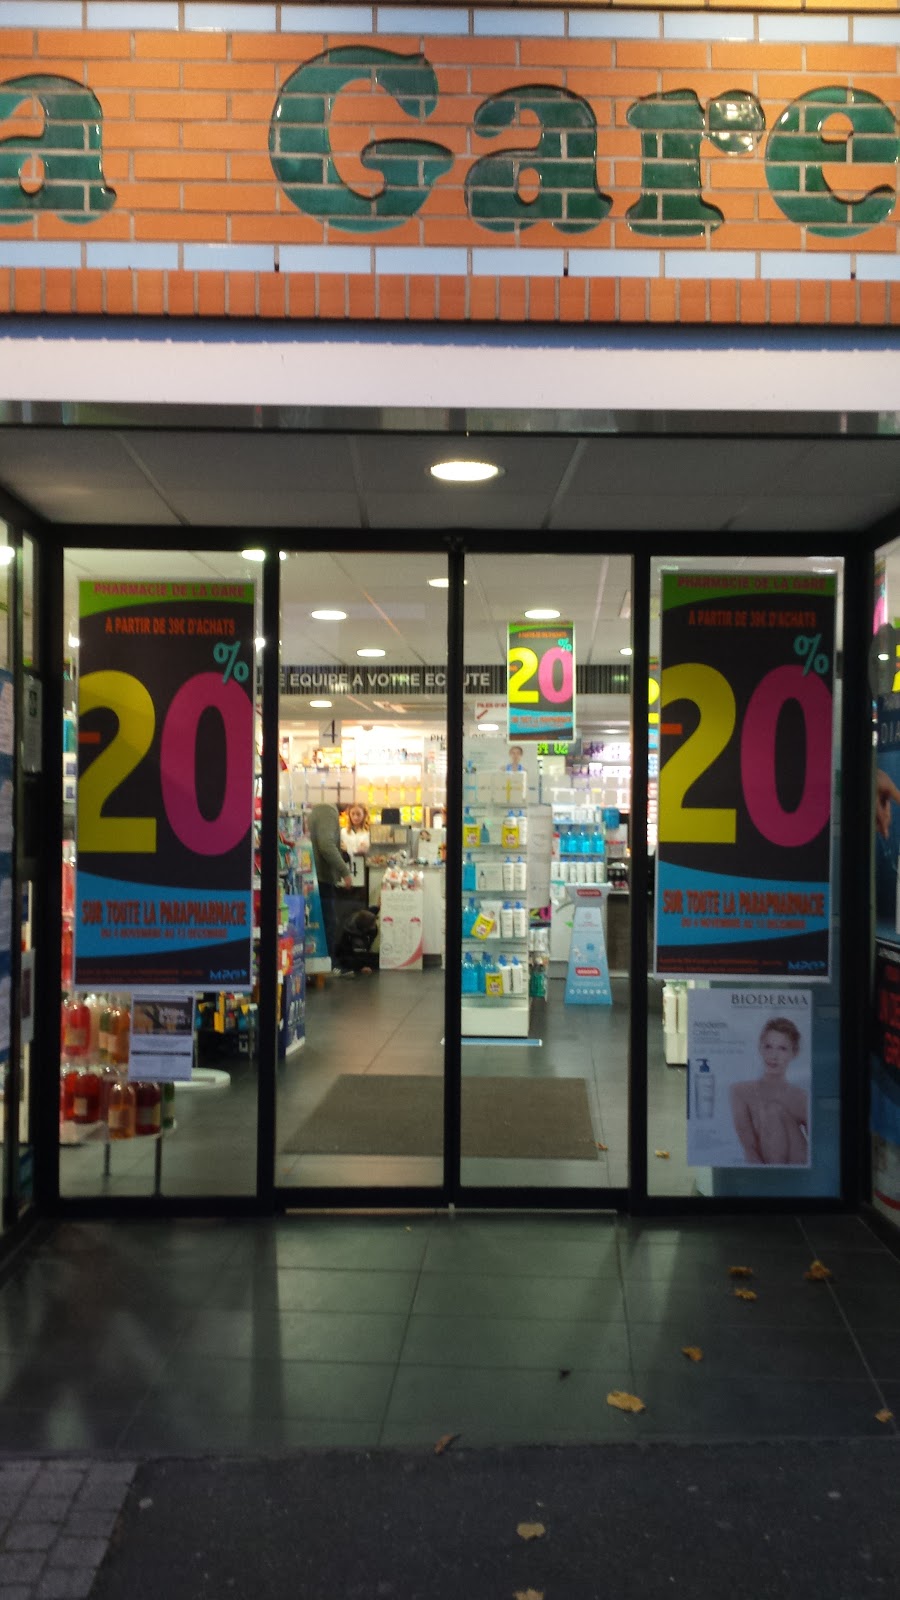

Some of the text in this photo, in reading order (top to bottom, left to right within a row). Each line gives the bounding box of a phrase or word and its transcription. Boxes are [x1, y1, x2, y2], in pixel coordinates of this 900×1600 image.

[268, 44, 900, 239] Gare
[94, 583, 246, 598] PHARMACIE DE LA GARE
[677, 576, 827, 590] PHARMACIE DE LA GARE
[105, 616, 113, 633] A
[115, 617, 150, 633] PARTIR
[153, 618, 166, 634] DE
[188, 618, 236, 635] D'ACHATS
[699, 610, 732, 626] PARTIR
[735, 611, 747, 626] DE
[290, 673, 348, 688] EQUIPE
[352, 673, 363, 686] A
[367, 673, 420, 687] VOTRE
[425, 672, 490, 687] ECUTE
[663, 889, 825, 916] SUR TOUTE LA PARAPHARMACIE
[82, 900, 247, 926] SUR TOUTE LA PARAPHARMACIE
[731, 993, 808, 1005] BIODERMA
